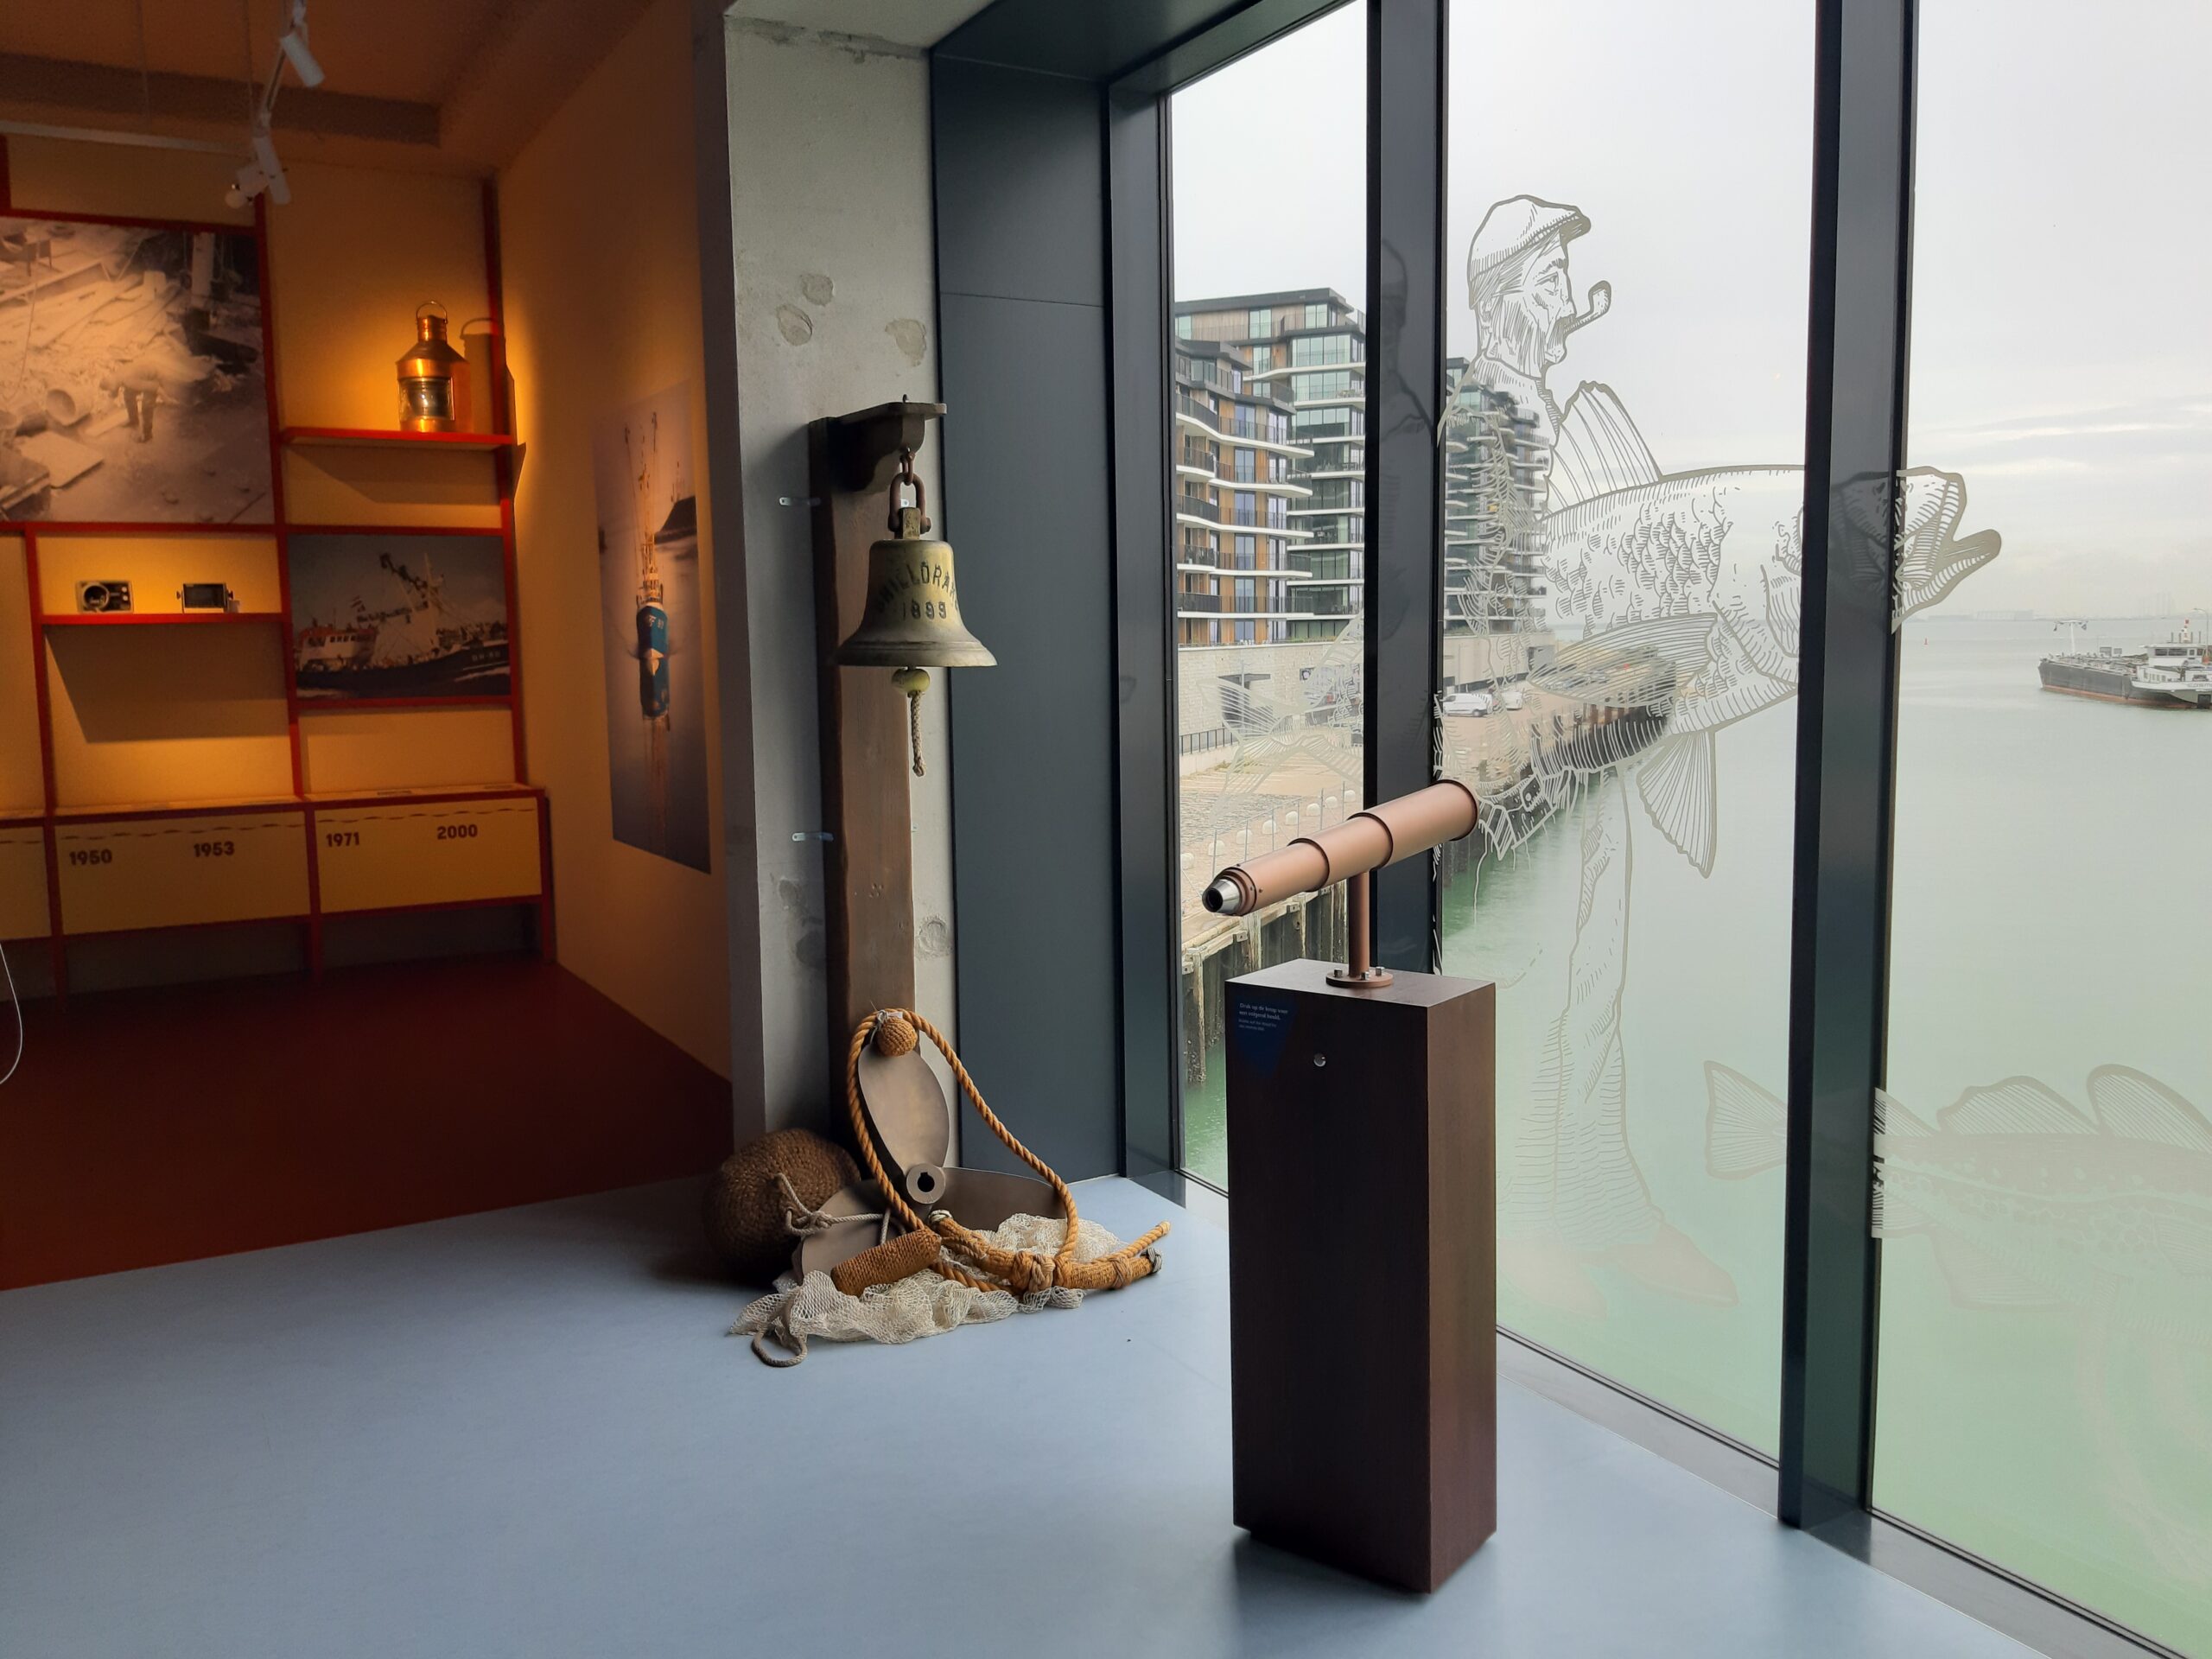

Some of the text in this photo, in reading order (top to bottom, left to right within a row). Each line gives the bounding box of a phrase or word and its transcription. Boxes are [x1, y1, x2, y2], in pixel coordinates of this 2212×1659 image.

[903, 599, 947, 620] 1899
[326, 832, 360, 847] 1971
[437, 824, 478, 840] 2000
[69, 849, 112, 865] 1950
[194, 841, 235, 857] 1953
